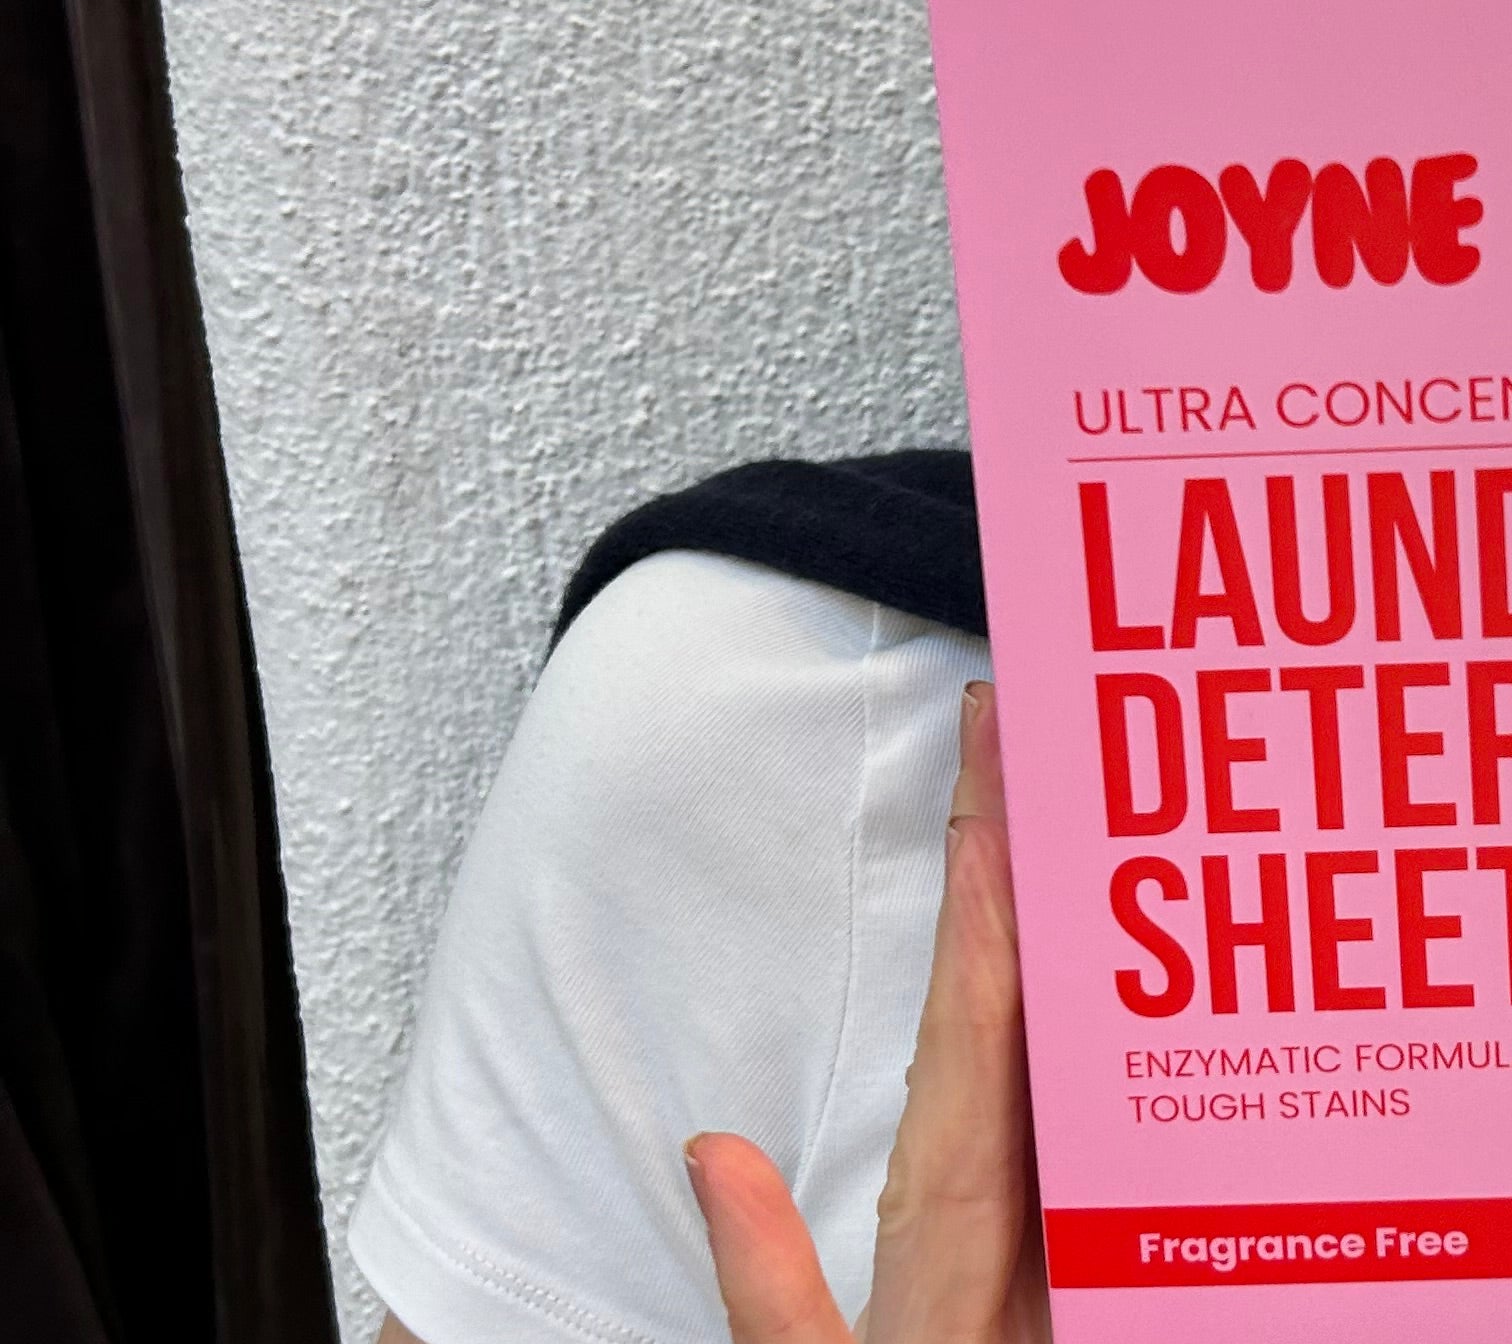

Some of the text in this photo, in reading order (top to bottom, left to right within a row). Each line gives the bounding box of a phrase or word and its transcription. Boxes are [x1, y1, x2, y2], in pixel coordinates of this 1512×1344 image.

[1058, 154, 1483, 294] JOYNE
[1076, 387, 1255, 435] ULTRA
[1126, 1046, 1340, 1078] ENZYMATIC
[1128, 1089, 1409, 1122] TOUGH STAINS
[1141, 1228, 1467, 1270] Fragrance Free
